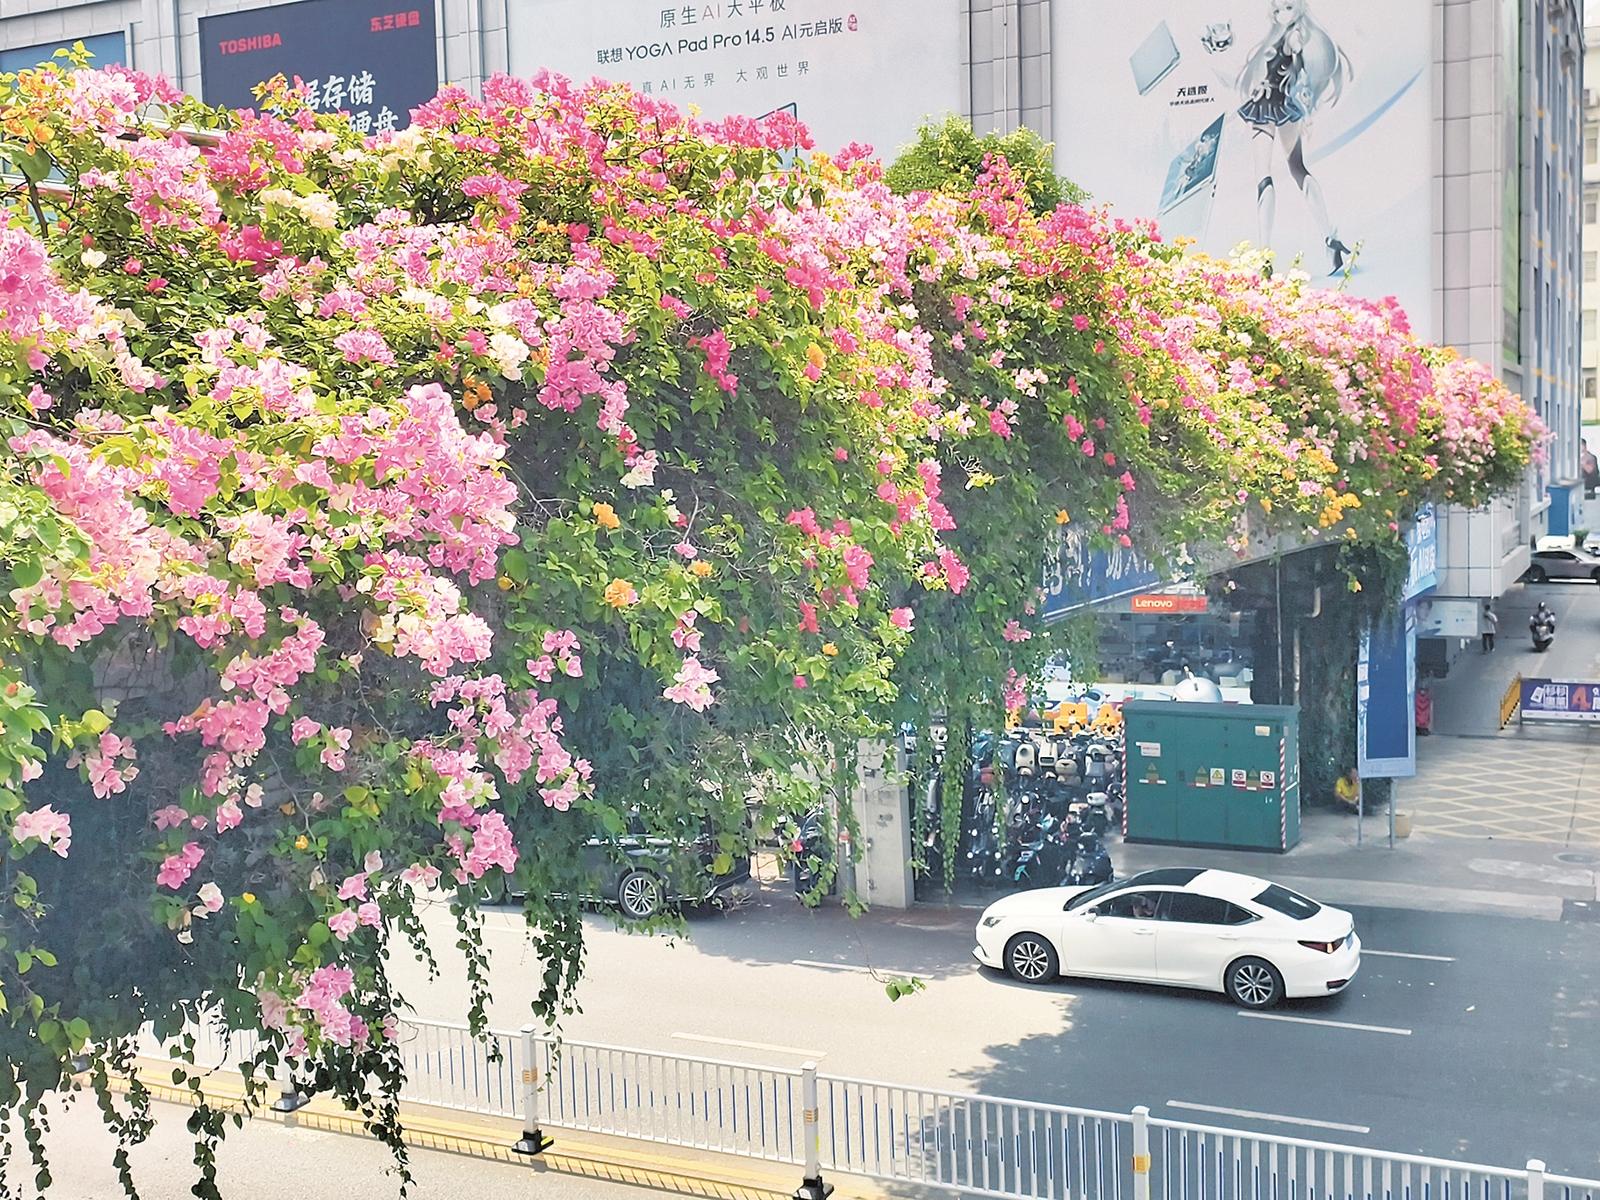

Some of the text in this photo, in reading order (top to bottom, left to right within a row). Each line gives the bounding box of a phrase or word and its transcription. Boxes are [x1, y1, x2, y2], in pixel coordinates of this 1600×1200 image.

[219, 32, 282, 55] TOSHIBA
[678, 36, 708, 54] Pad
[745, 26, 775, 45] 14.5
[1135, 598, 1173, 608] Lenovo
